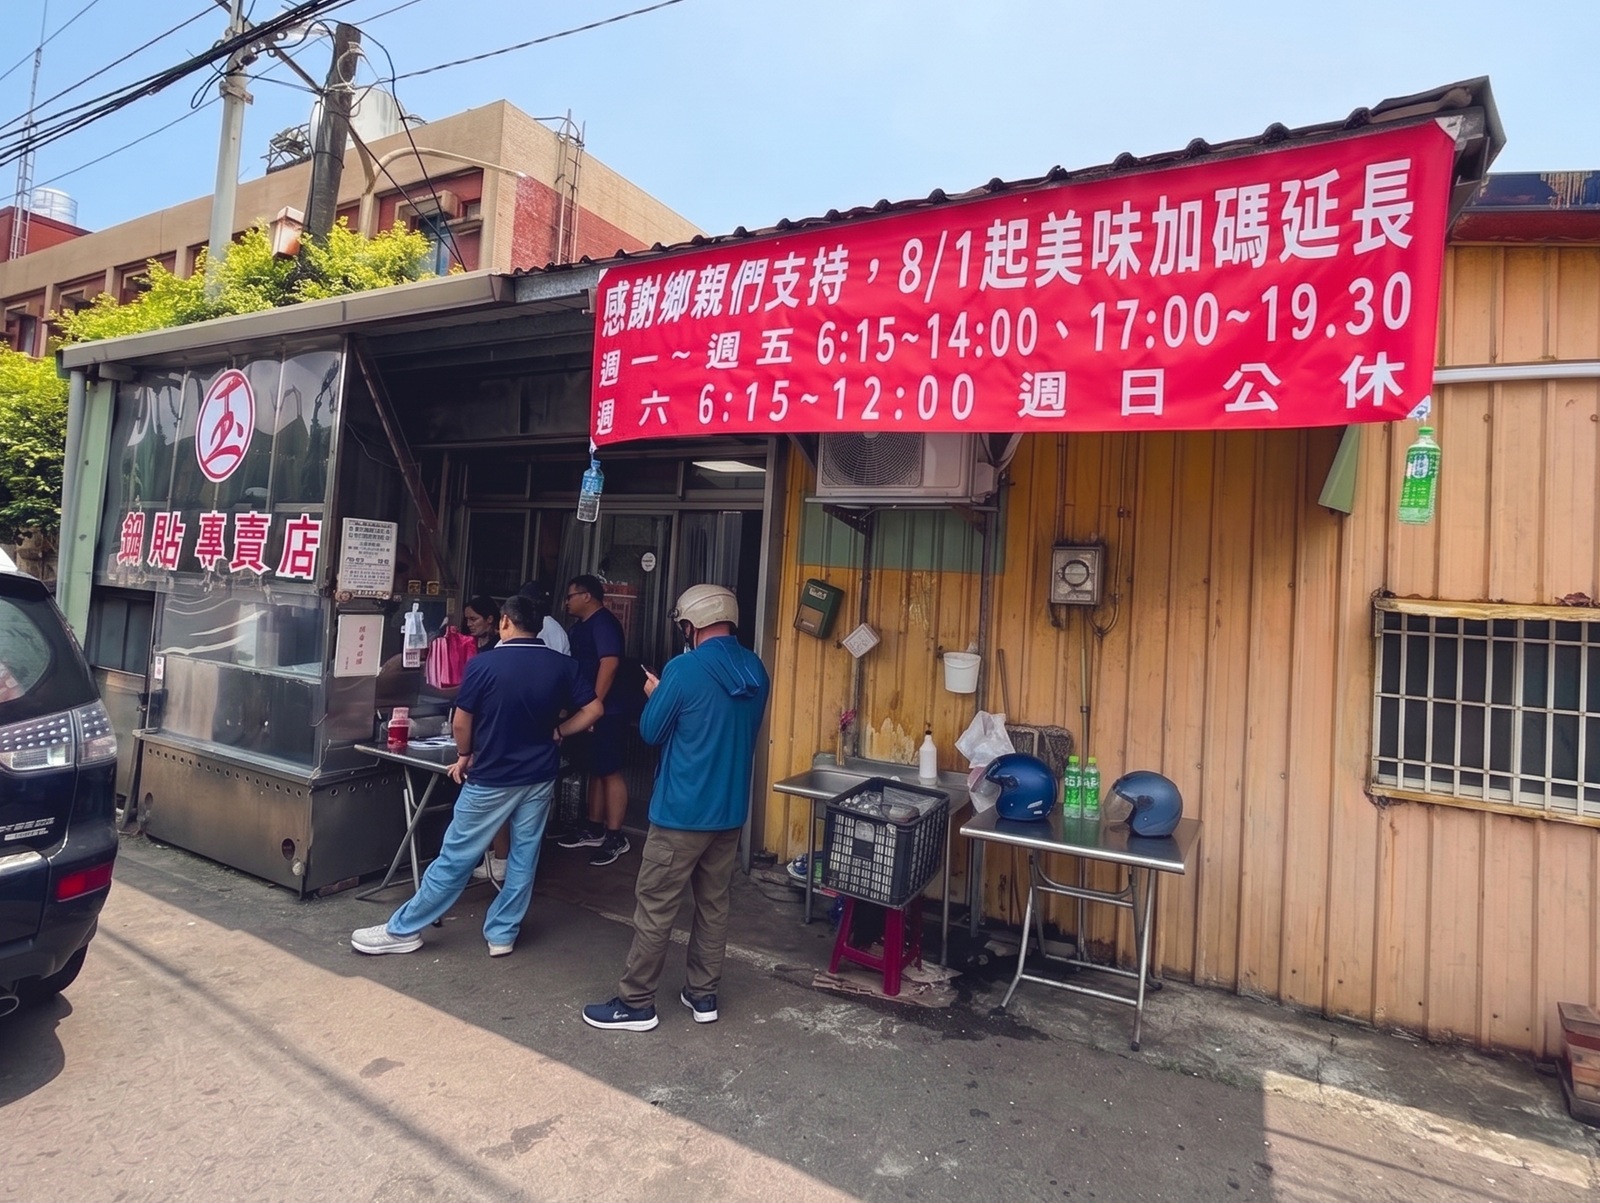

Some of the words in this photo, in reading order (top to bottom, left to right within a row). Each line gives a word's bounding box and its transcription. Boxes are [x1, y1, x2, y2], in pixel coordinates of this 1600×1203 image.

[602, 158, 1415, 338] 感謝鄉親們支持，8/1起美味加碼延長
[1017, 350, 1406, 419] 週日公休
